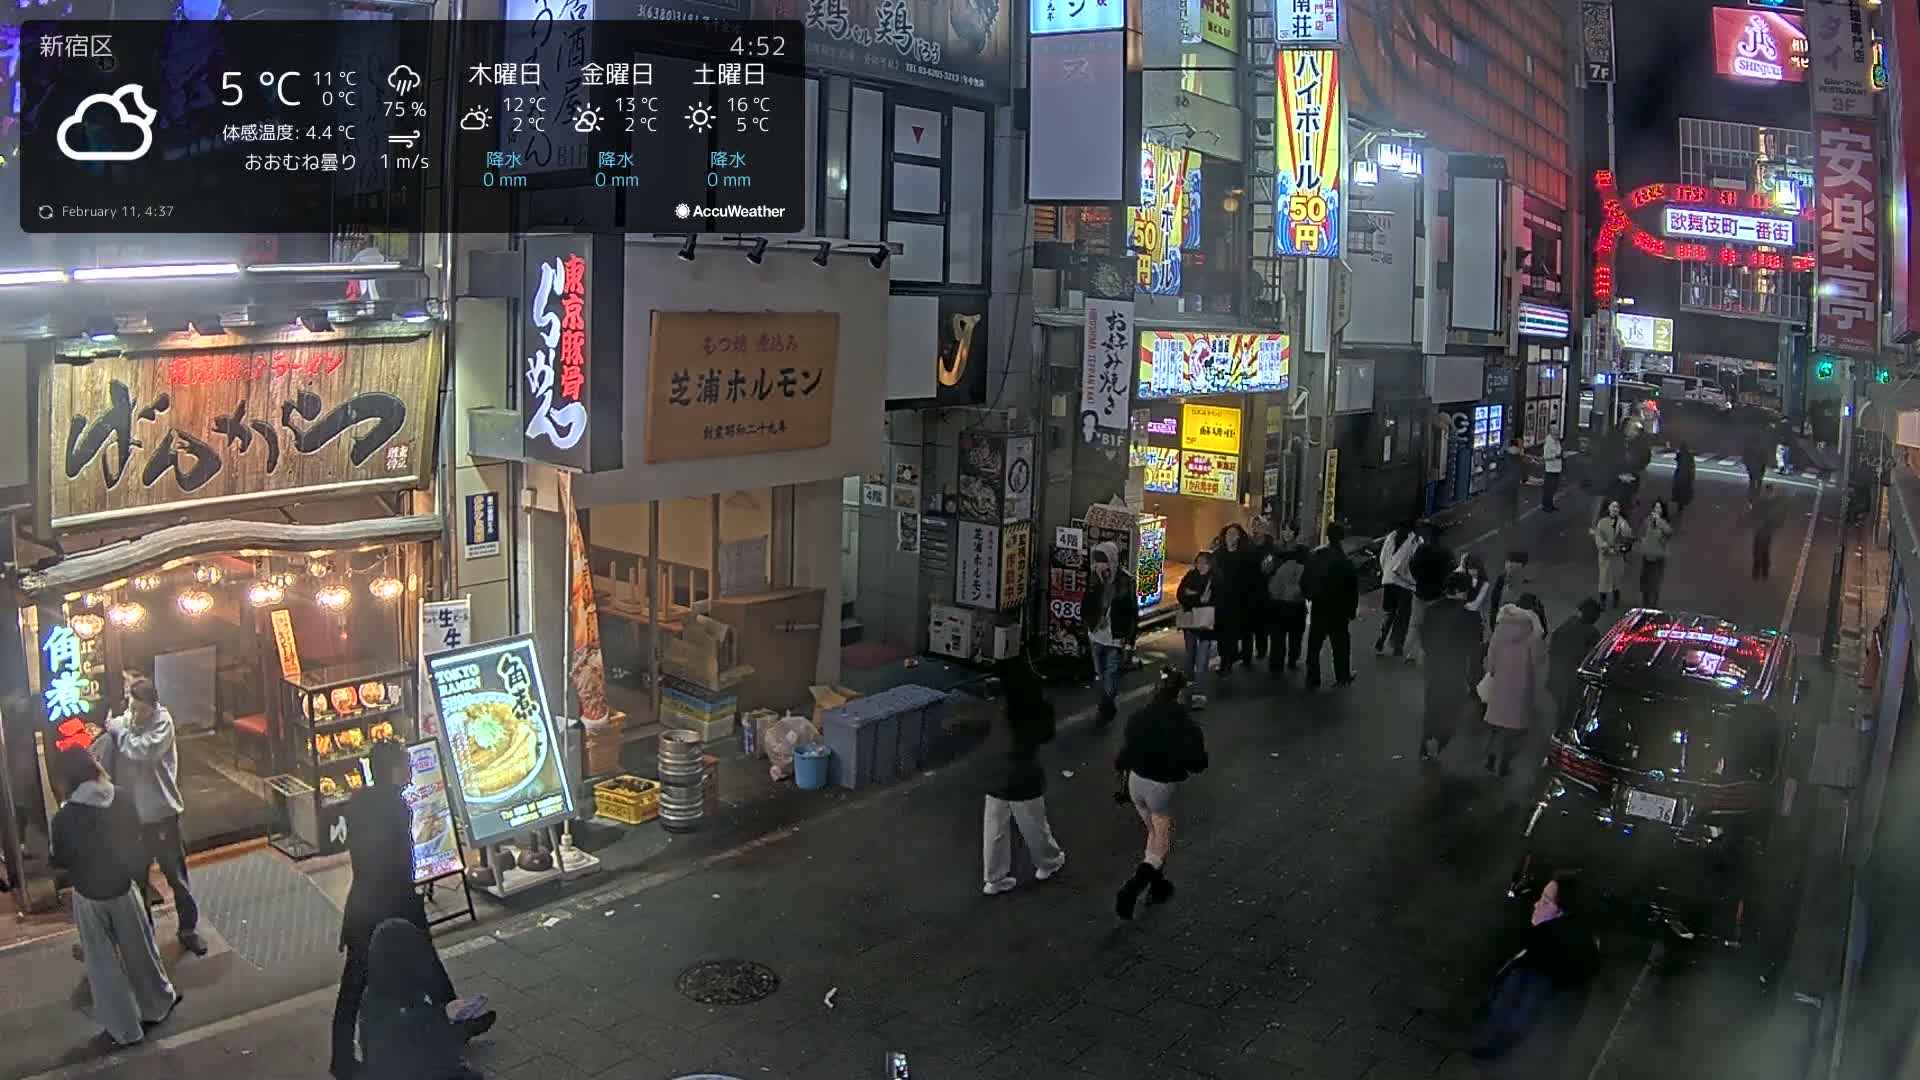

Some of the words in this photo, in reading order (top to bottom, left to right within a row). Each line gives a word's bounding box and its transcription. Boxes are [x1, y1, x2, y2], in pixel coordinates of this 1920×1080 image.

[1589, 63, 1609, 80] 7F
[1296, 55, 1323, 190] ハイボール
[1161, 150, 1178, 289] ハイボール
[1289, 196, 1327, 222] 50
[1134, 219, 1157, 251] 50
[1295, 224, 1320, 250] 円
[1670, 211, 1790, 242] 歌舞伎町一番街
[1819, 127, 1877, 330] 安楽亭
[1136, 253, 1152, 289] 円
[560, 253, 585, 402] 東京豚骨
[669, 366, 824, 406] 芝浦ホルモン
[1101, 432, 1125, 447] B1F
[43, 625, 90, 722] 角煮
[434, 662, 480, 683] TOKYO
[438, 677, 482, 698] RAMEN
[498, 652, 541, 721] 角煮
